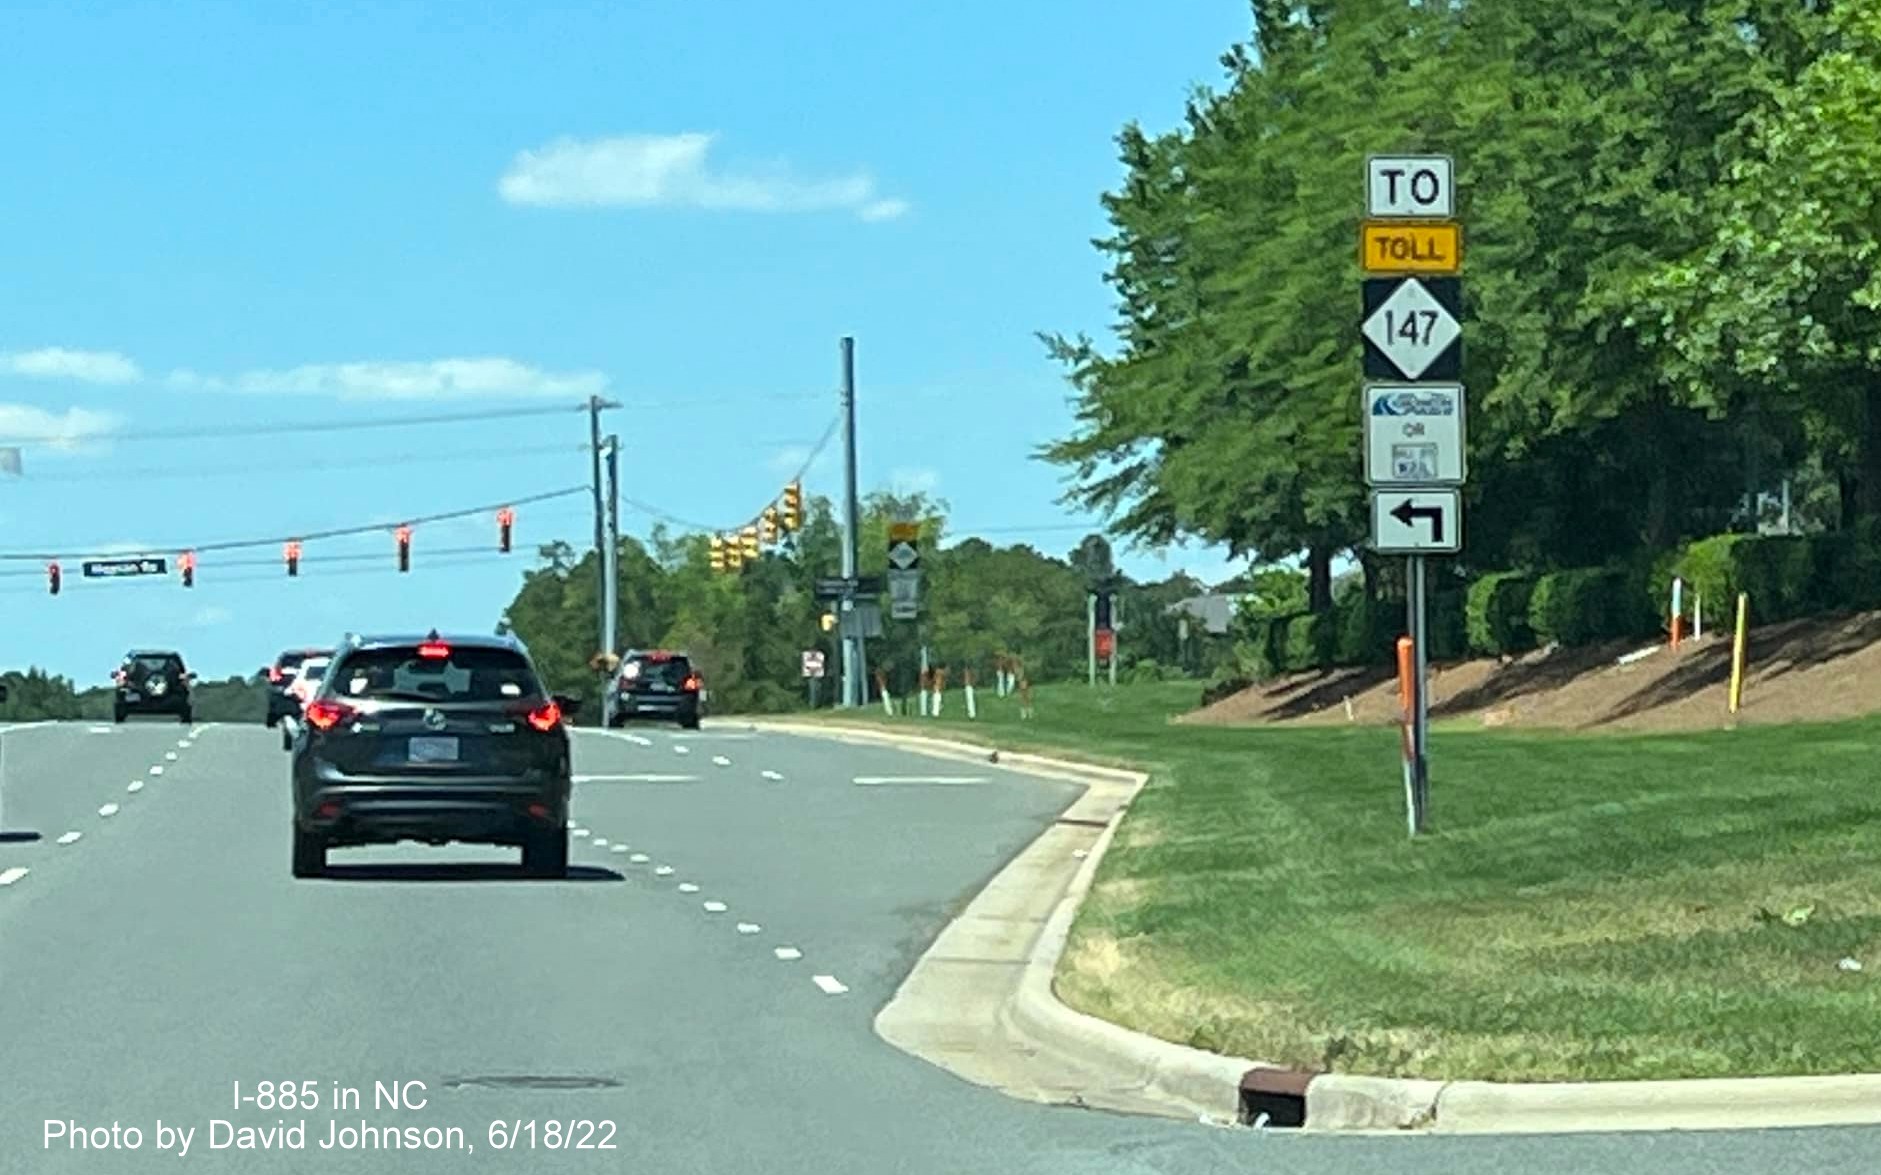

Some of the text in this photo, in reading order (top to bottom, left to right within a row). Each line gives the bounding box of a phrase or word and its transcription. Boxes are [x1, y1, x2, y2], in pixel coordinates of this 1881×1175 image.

[1380, 168, 1439, 205] TO
[1374, 235, 1446, 261] TOLL
[1385, 310, 1438, 346] 147
